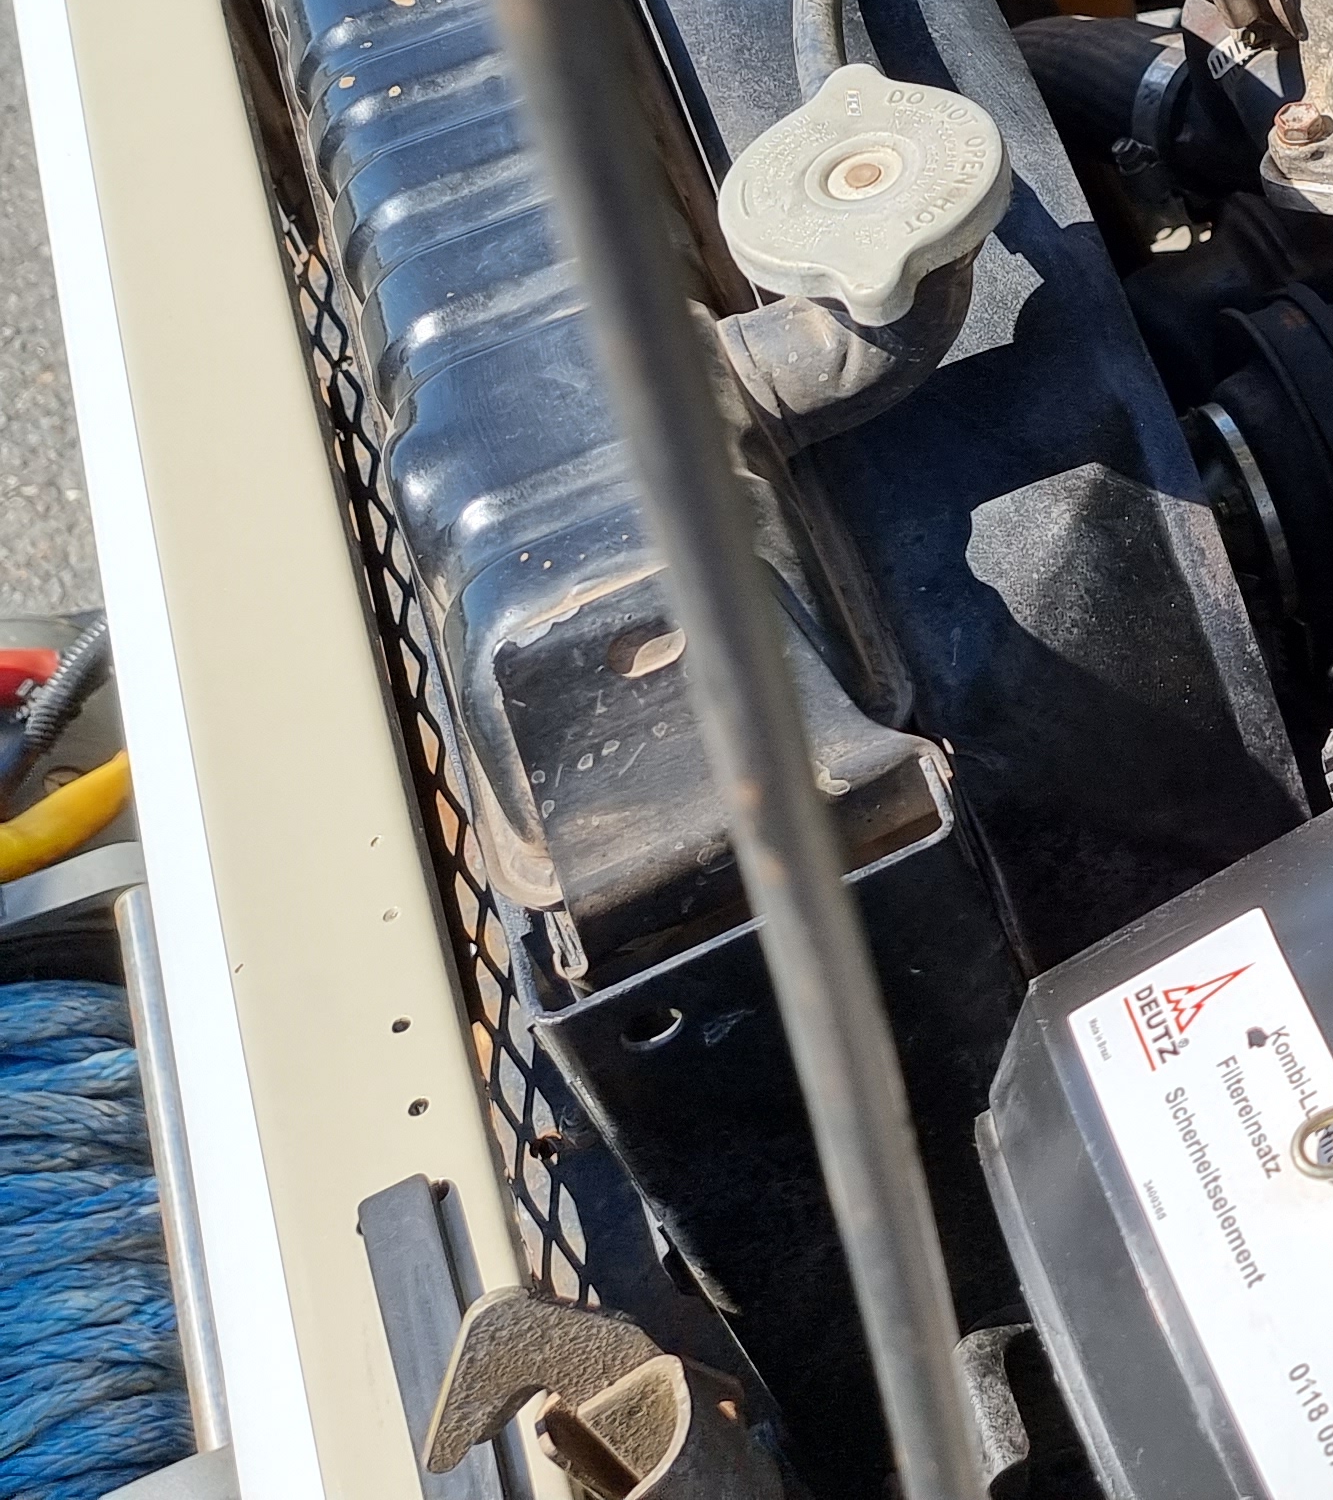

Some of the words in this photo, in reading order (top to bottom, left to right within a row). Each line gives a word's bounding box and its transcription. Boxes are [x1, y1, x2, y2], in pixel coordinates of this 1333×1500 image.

[1132, 983, 1182, 1066] DEUTZ
[1216, 1053, 1282, 1180] Filtereinsatz
[1164, 1085, 1267, 1290] Sicherheitselement
[1288, 1362, 1329, 1424] 0118
